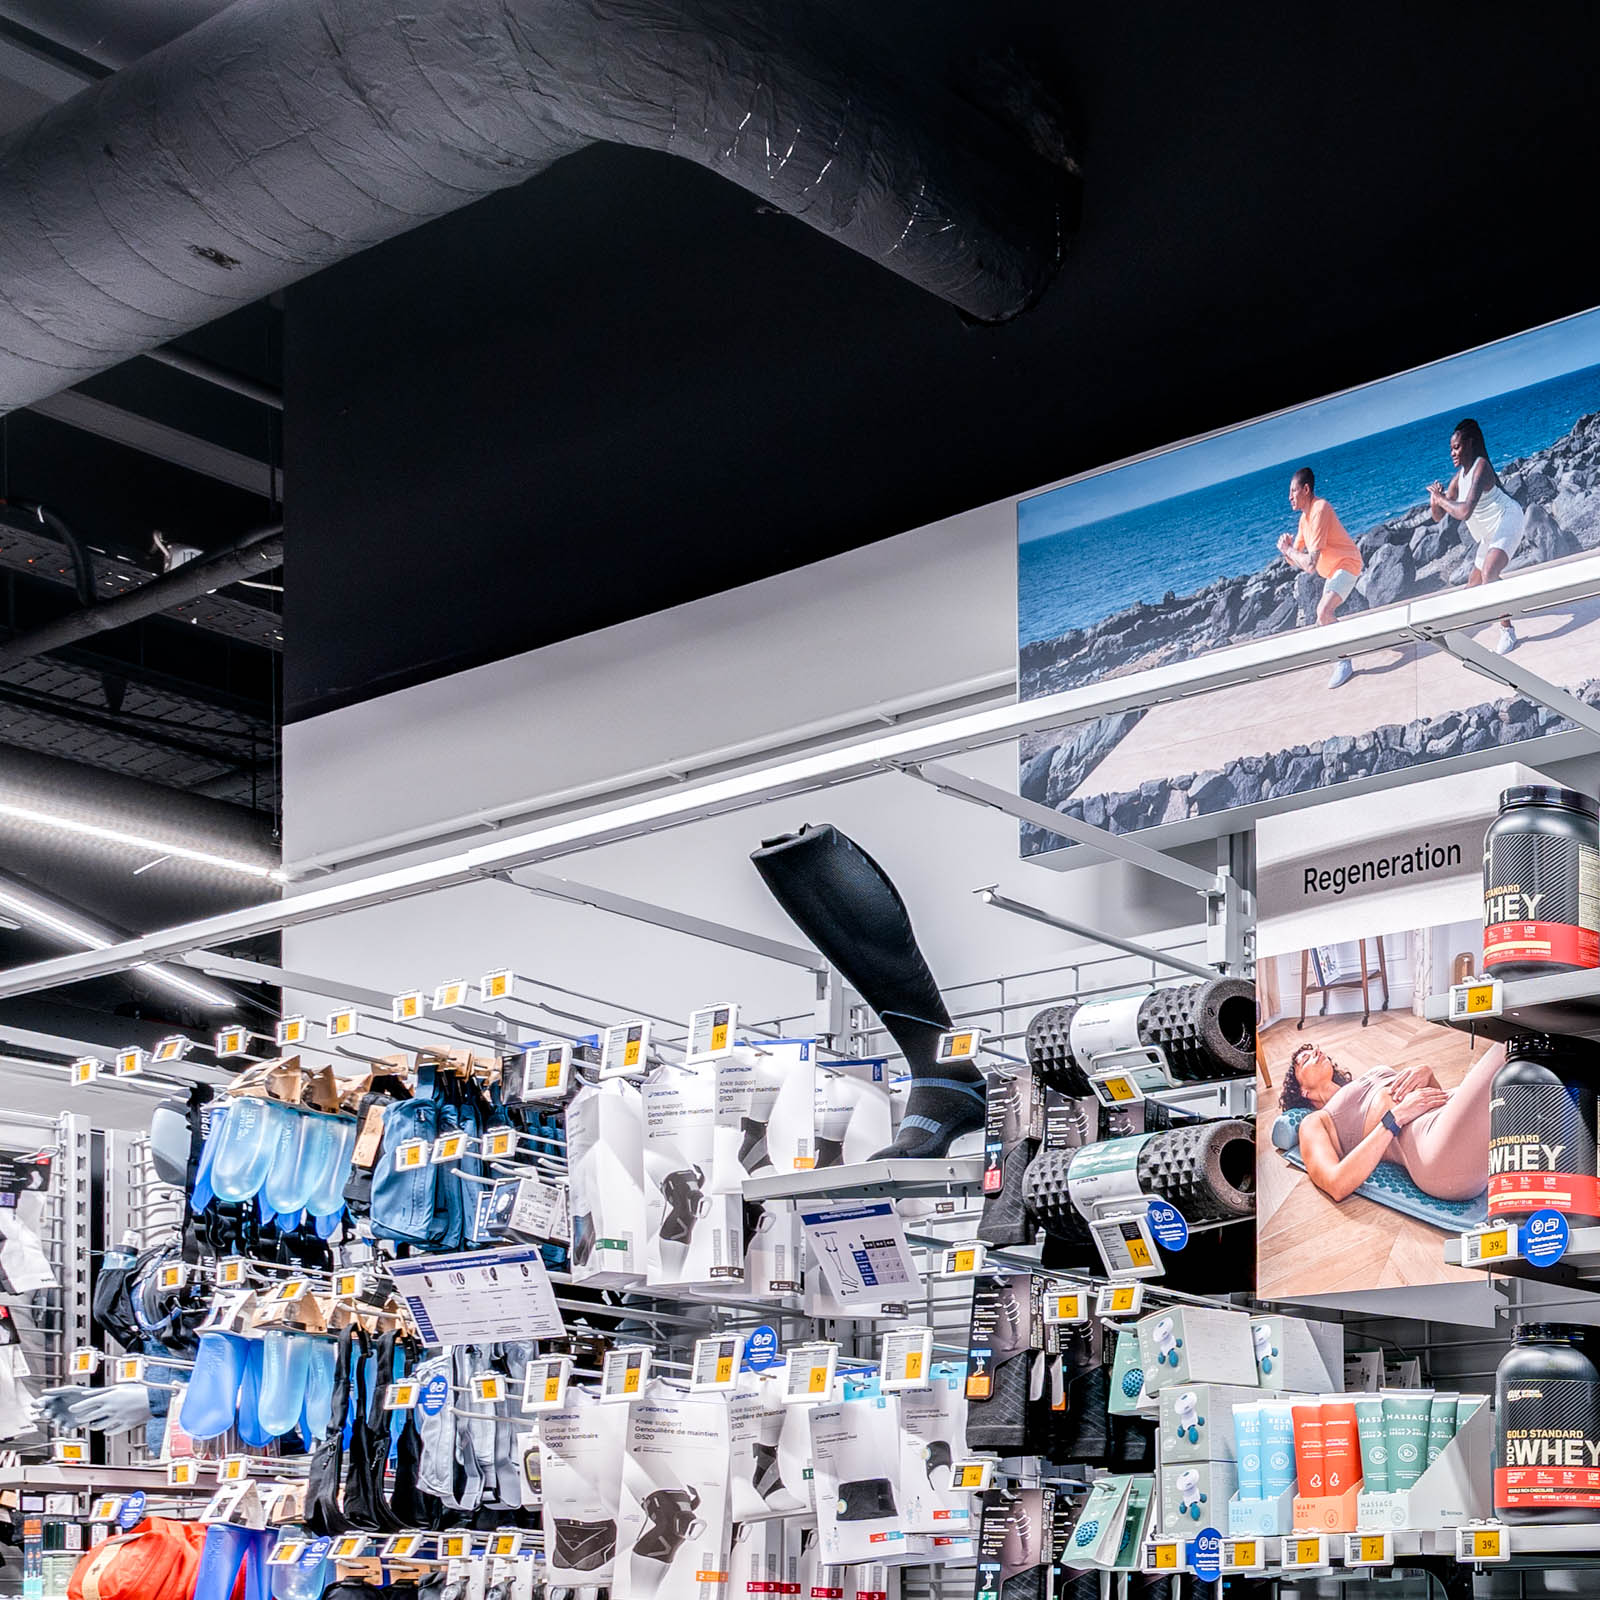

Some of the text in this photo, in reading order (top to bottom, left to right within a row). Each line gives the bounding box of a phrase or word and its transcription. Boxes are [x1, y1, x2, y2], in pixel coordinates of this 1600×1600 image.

[1303, 843, 1461, 894] Regeneration
[1387, 1413, 1429, 1422] MASSAGE
[1532, 1429, 1584, 1440] STANDARD
